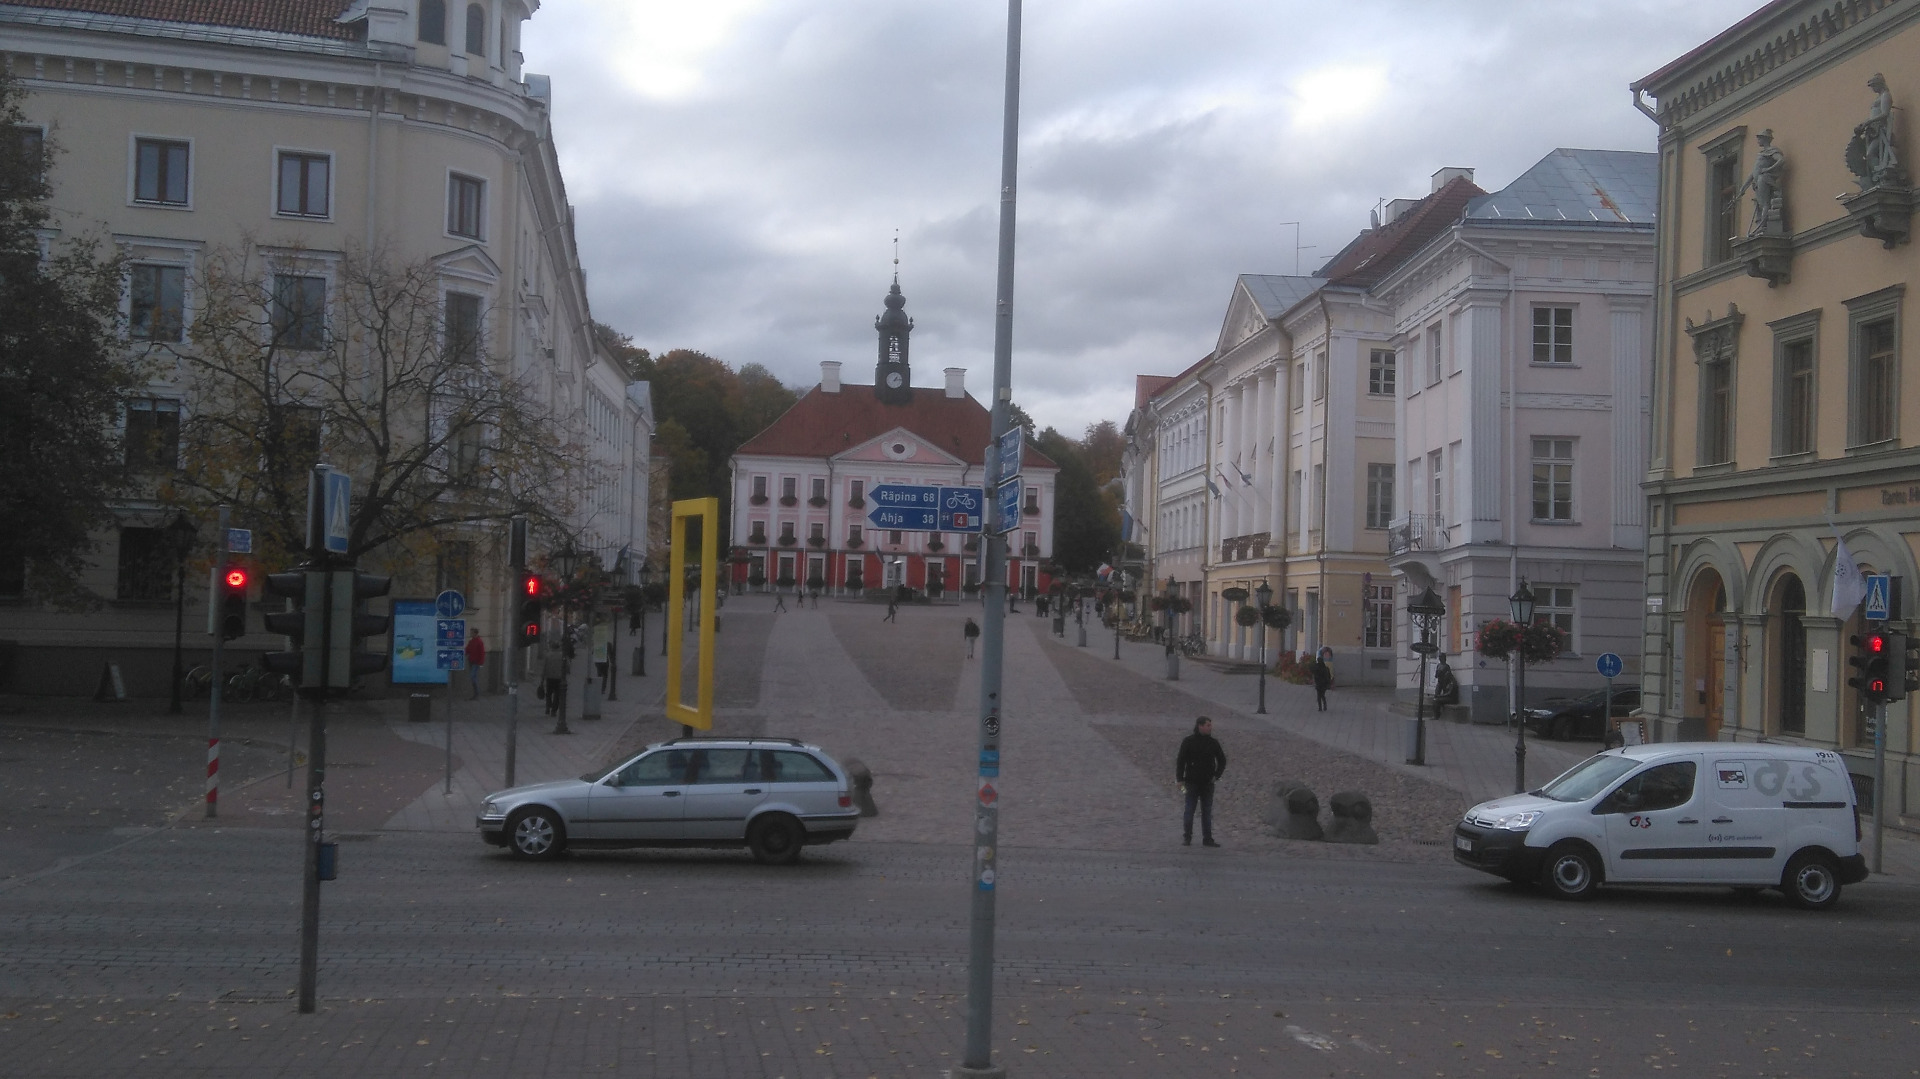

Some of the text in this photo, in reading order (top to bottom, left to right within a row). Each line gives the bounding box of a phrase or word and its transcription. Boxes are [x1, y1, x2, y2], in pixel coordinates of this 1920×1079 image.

[881, 491, 935, 503] Räpina 68
[880, 513, 934, 525] Ahja 38
